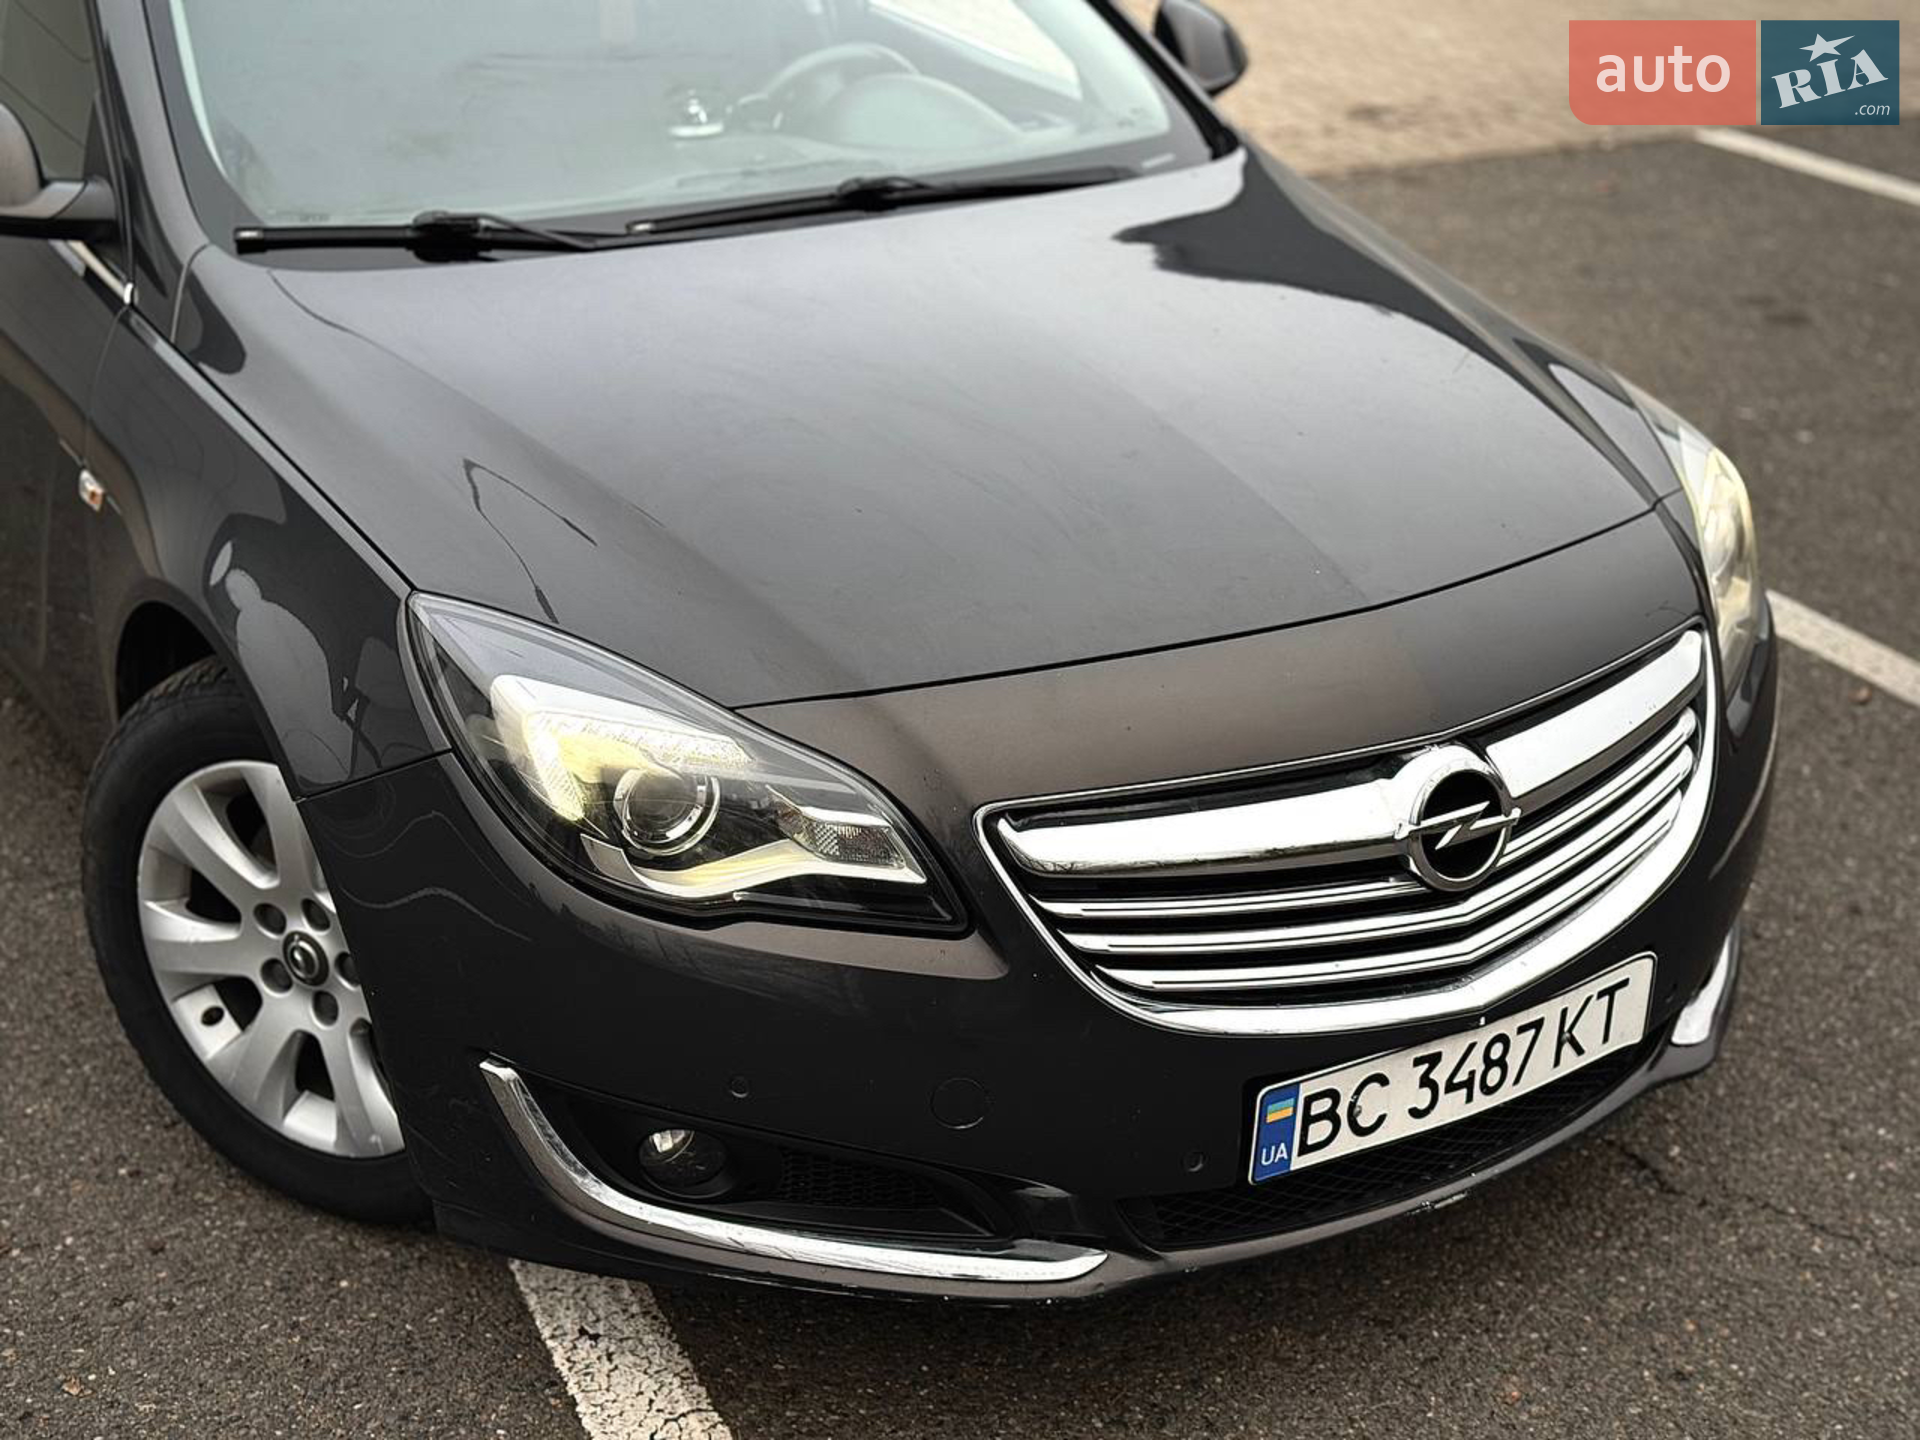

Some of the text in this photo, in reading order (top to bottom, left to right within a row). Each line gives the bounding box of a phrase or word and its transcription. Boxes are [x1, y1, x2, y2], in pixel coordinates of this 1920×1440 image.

[1297, 977, 1631, 1158] BC 3487 KT
[1260, 1142, 1289, 1167] UA
